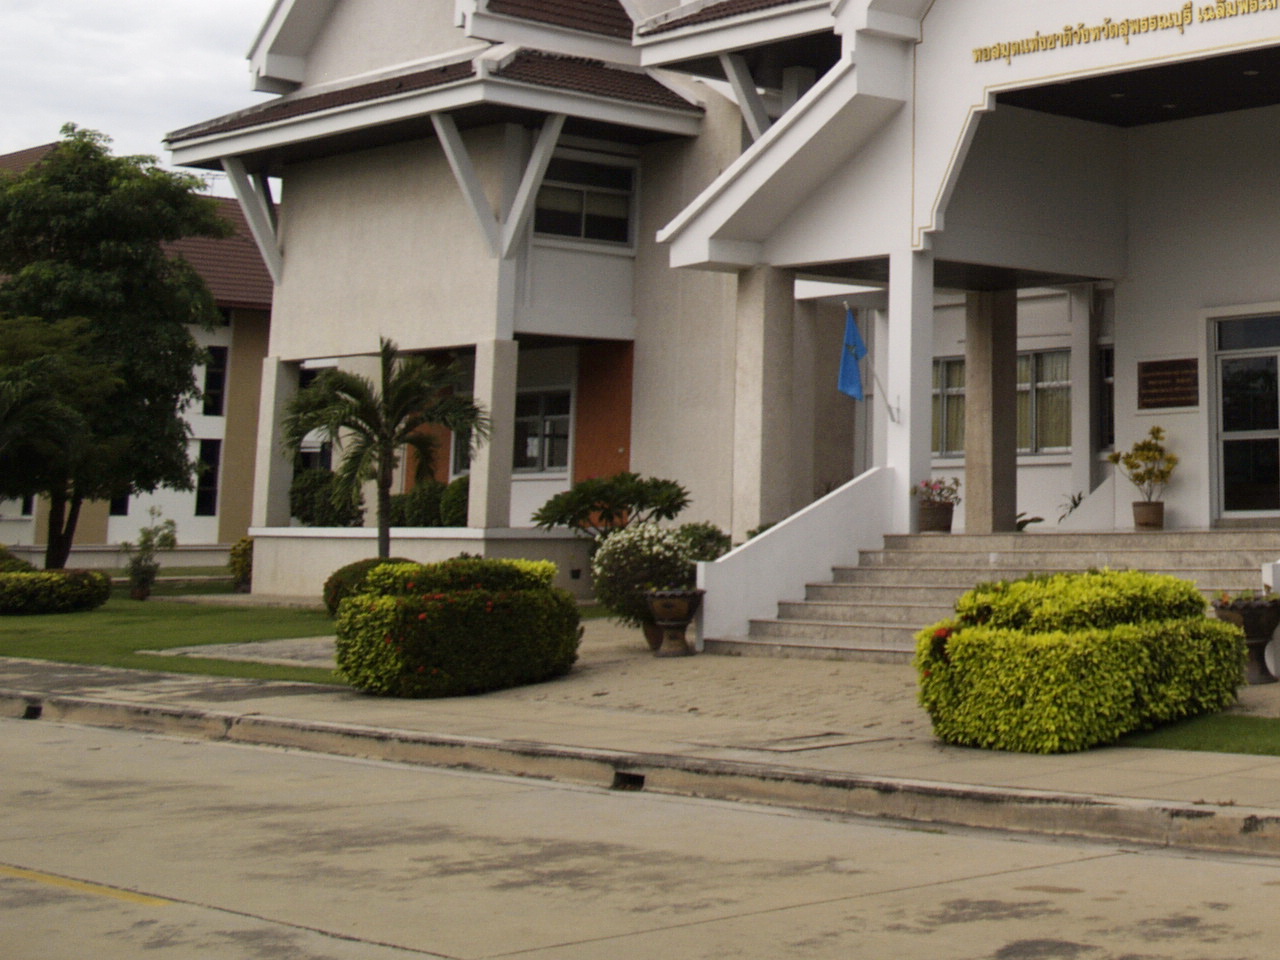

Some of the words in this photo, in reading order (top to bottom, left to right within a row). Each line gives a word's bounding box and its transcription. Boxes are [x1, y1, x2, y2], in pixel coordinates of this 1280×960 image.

[972, 0, 1193, 65] หอสมุดแห่งชาติจังหวัดสุพรรณบุรี
